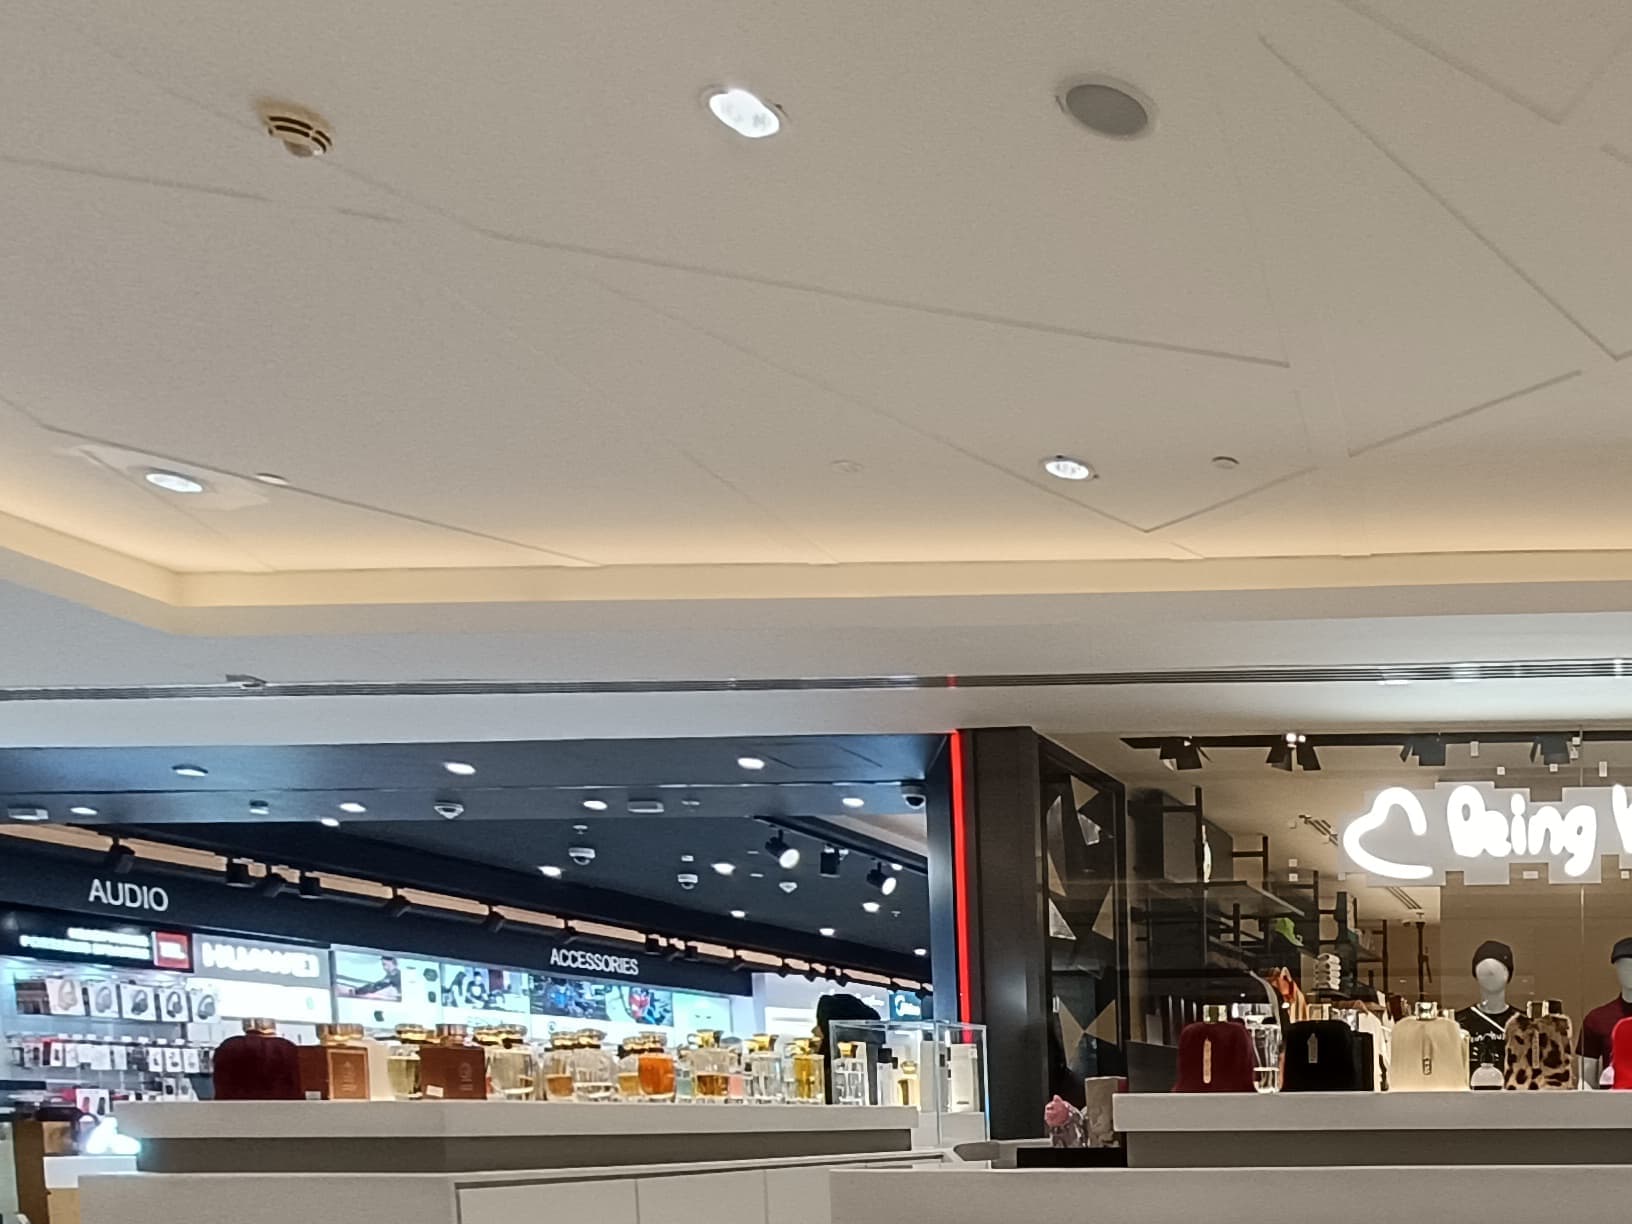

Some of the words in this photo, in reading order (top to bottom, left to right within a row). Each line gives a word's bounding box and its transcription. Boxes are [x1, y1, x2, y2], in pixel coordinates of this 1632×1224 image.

[1446, 784, 1597, 877] Being
[88, 878, 169, 912] AUDIO
[549, 948, 639, 976] ACCESSORIES
